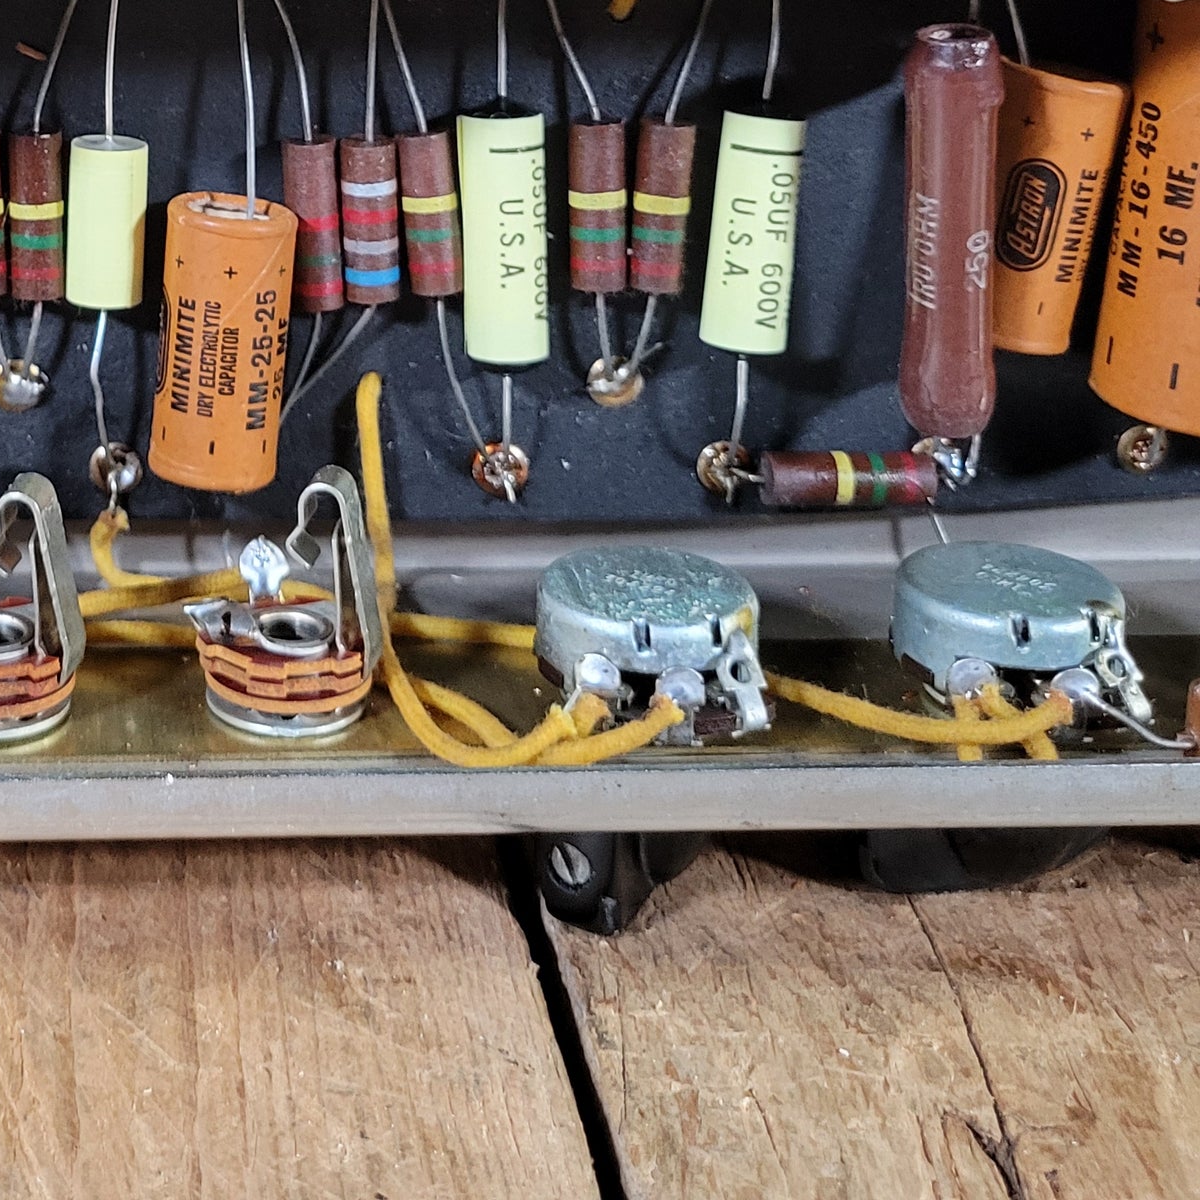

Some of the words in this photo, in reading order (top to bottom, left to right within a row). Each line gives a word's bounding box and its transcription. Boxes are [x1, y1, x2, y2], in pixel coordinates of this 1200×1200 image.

[766, 163, 794, 243] .05UF
[1006, 172, 1048, 260] ASTRON
[1055, 169, 1099, 283] MINIMITE
[1163, 162, 1199, 210] MF.
[499, 199, 525, 289] U.S.A.
[722, 198, 757, 286] U.S.A.
[965, 229, 990, 292] 250
[1156, 225, 1188, 265] 16
[534, 256, 549, 321] 600V
[755, 262, 784, 329] 600V
[171, 295, 196, 413] MINIMITE
[200, 300, 222, 388] ELECTROLYTIC
[218, 327, 240, 396] CAPACITOR
[245, 289, 277, 431] MM-25-25
[196, 391, 215, 417] DRY
